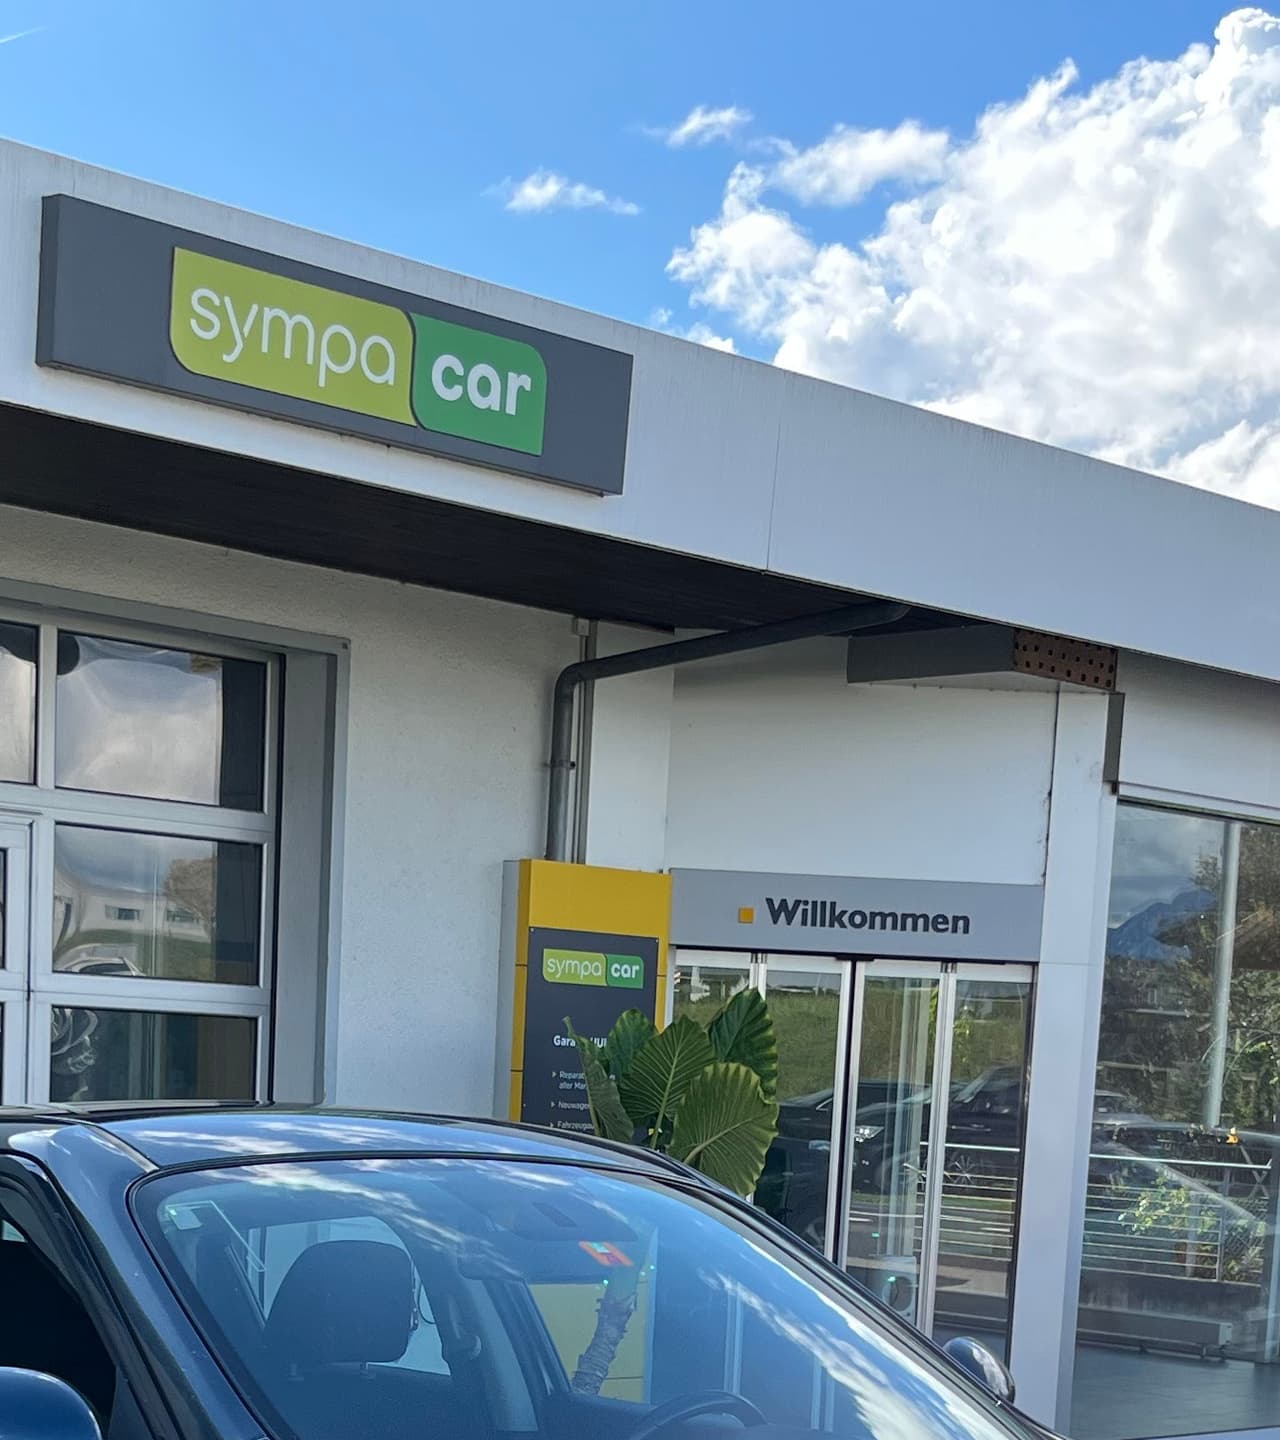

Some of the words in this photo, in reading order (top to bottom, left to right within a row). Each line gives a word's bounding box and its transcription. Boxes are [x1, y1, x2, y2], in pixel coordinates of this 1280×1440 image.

[189, 288, 396, 388] sympa
[431, 354, 531, 416] car
[765, 897, 971, 935] Willkommen
[547, 958, 602, 980] sympa
[610, 962, 640, 978] car
